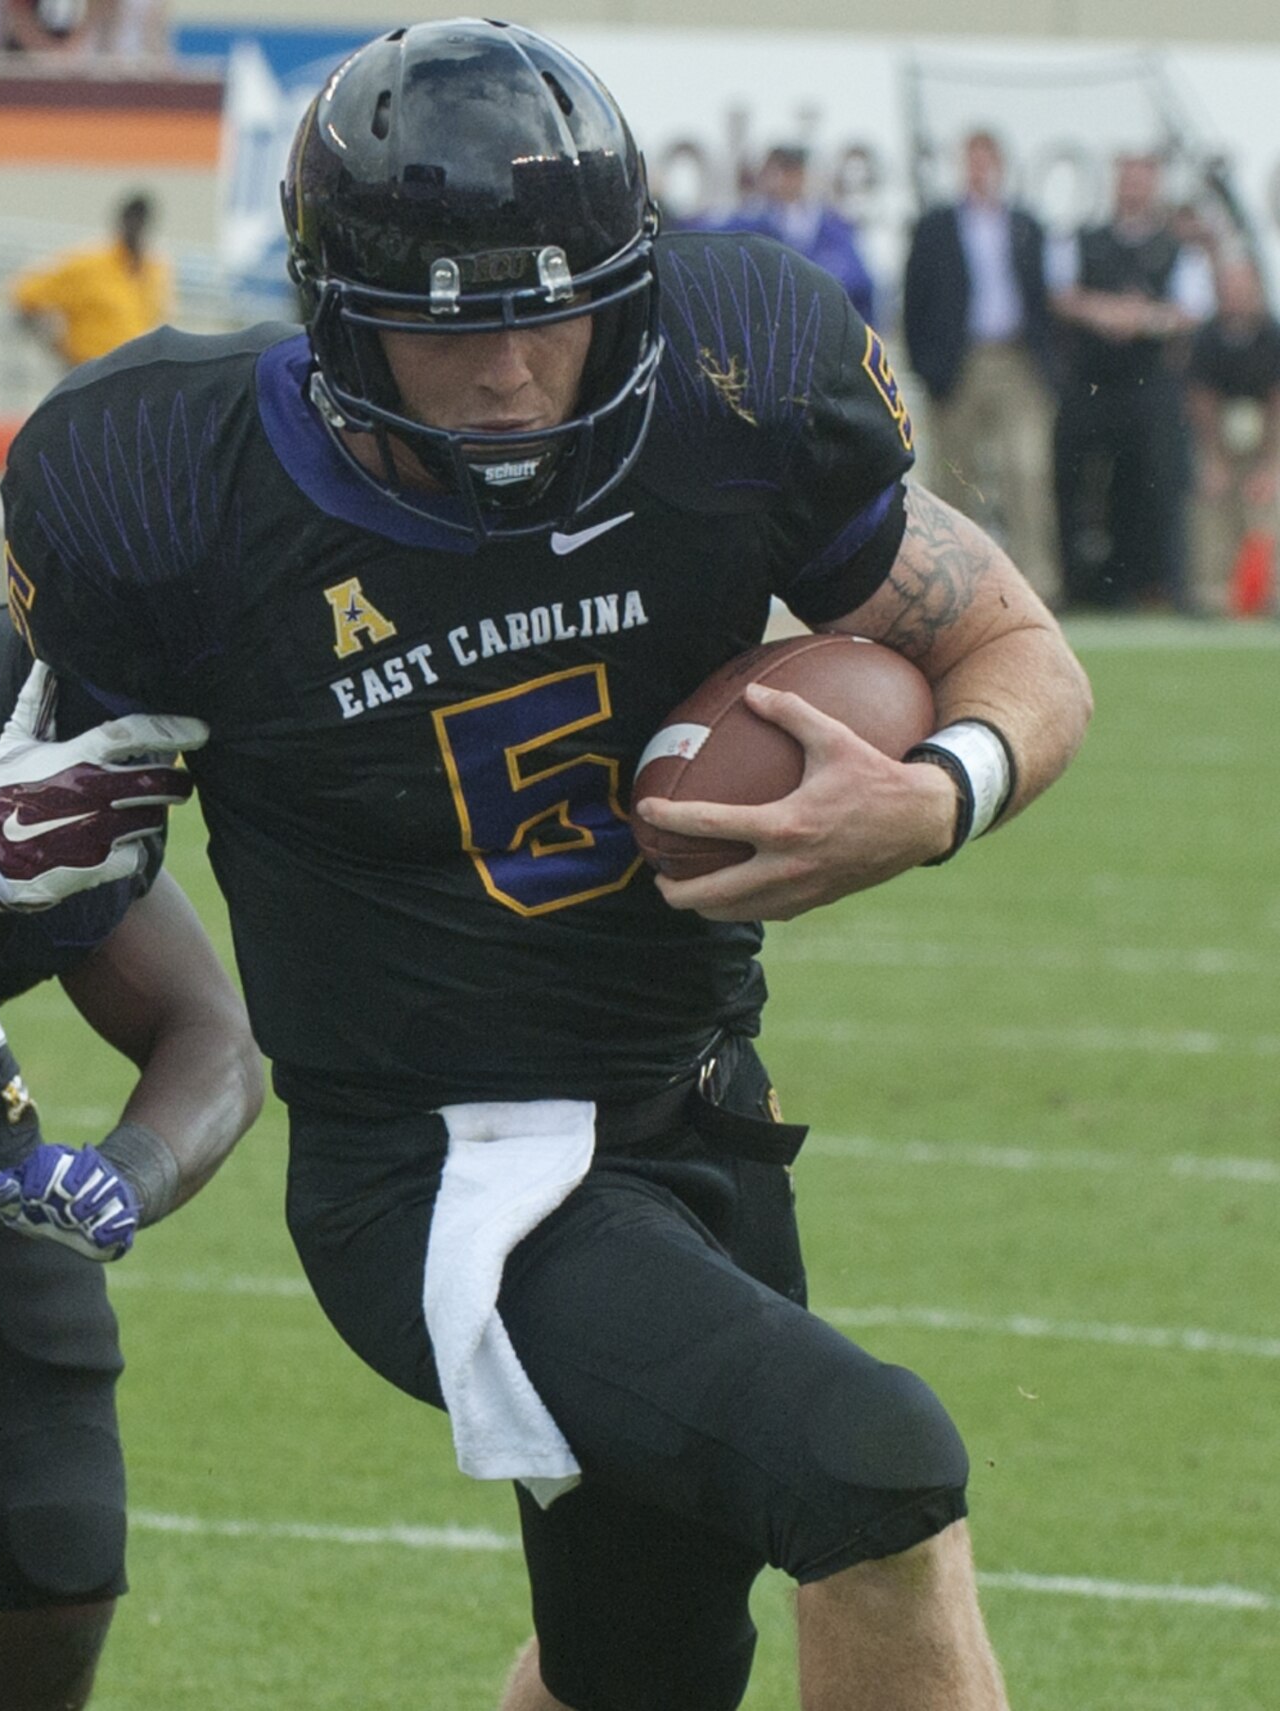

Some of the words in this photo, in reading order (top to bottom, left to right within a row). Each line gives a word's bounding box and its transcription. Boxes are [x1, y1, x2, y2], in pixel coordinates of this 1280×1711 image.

[329, 644, 440, 719] EAST
[447, 590, 649, 667] CAROLINA
[431, 662, 642, 917] 5
